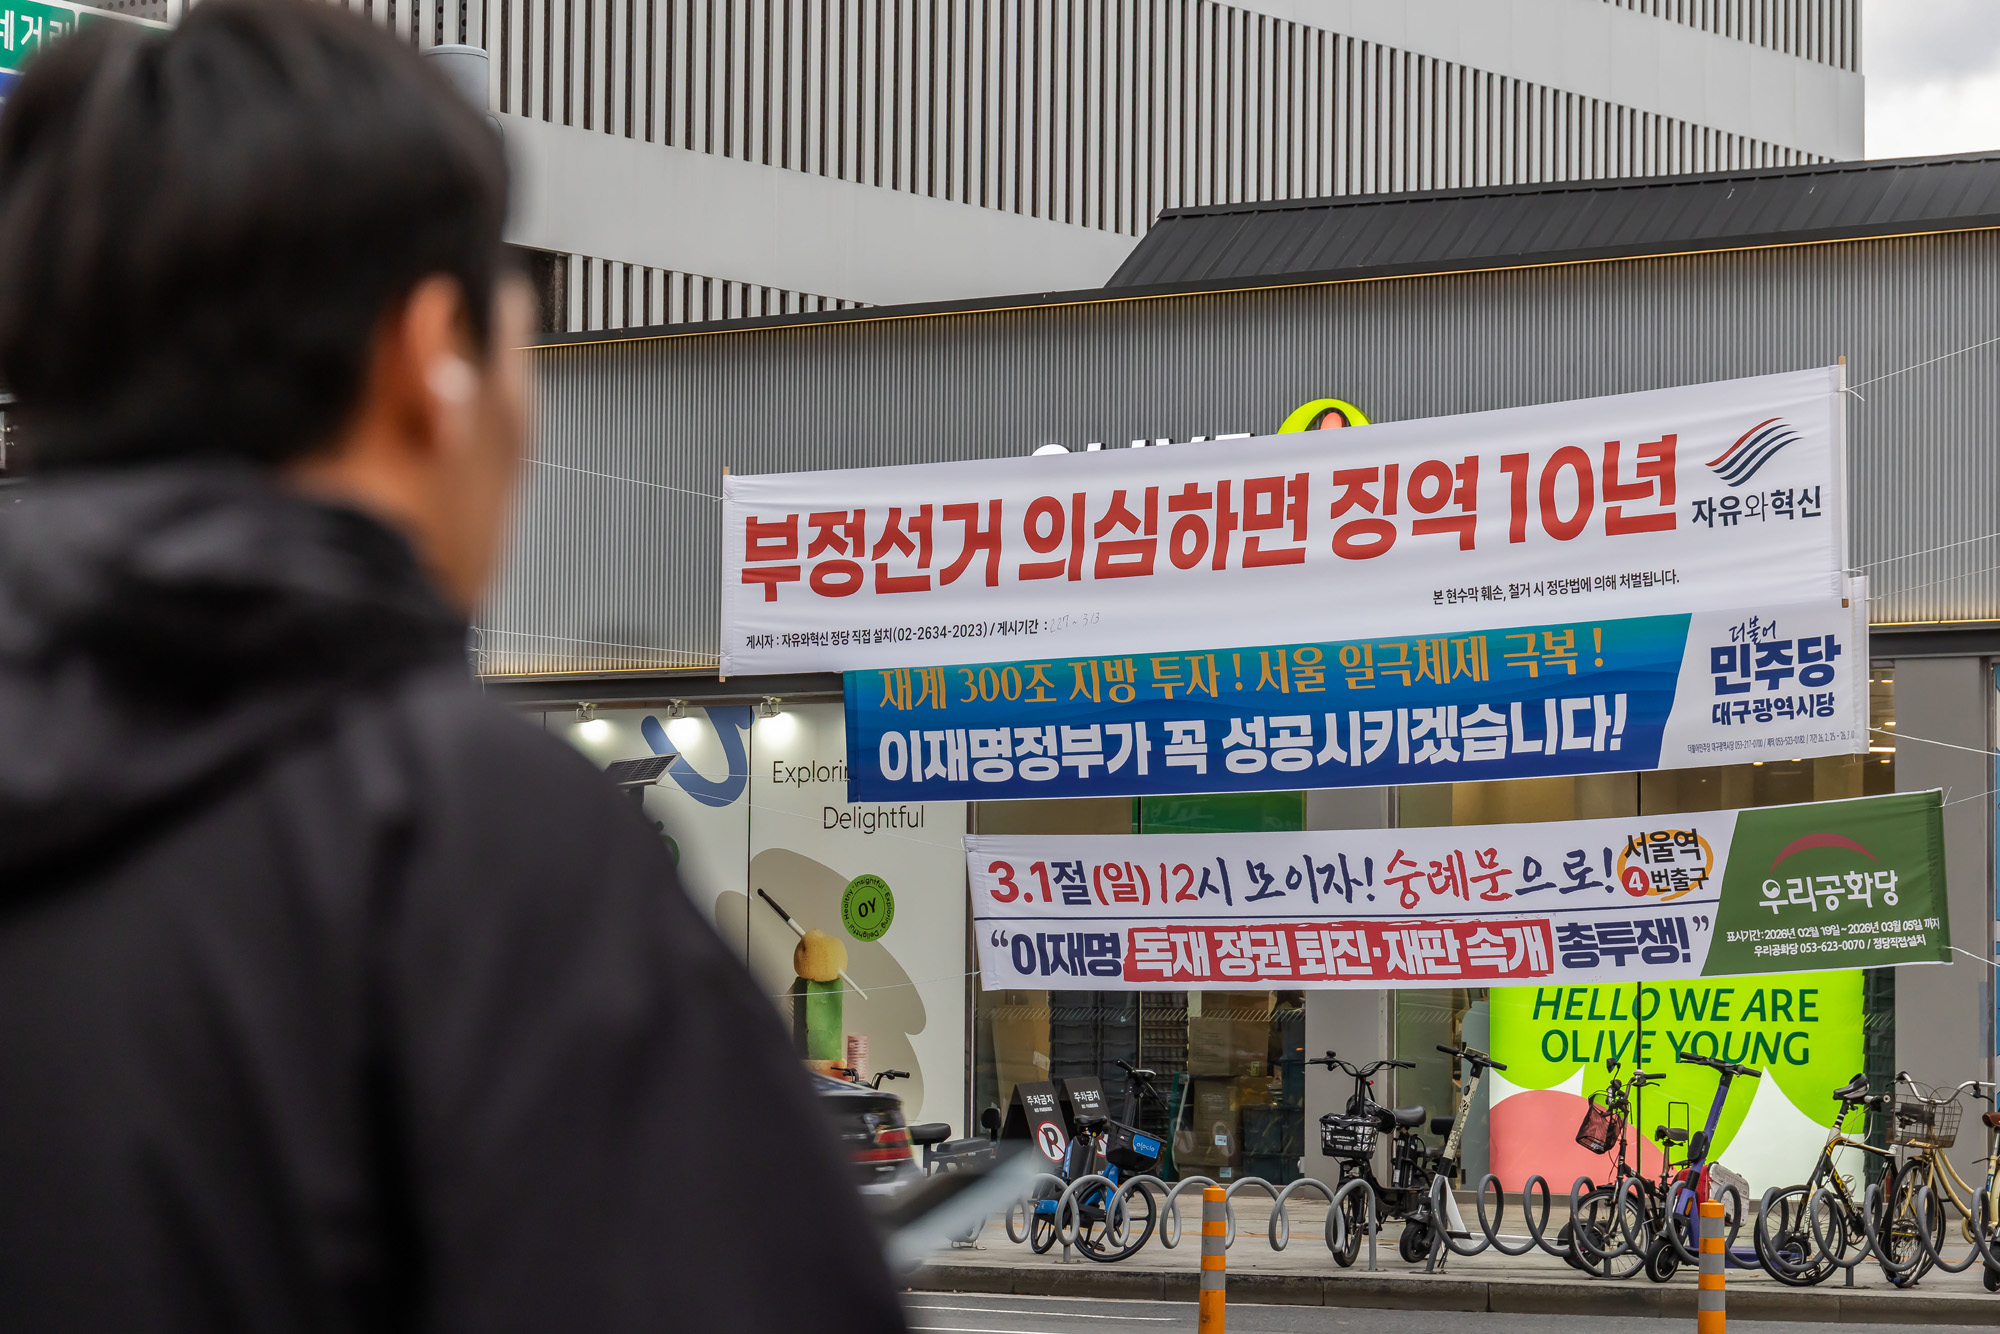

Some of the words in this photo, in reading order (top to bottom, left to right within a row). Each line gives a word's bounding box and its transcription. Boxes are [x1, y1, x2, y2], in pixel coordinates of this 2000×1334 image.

[741, 498, 1002, 602] 부정선거
[1018, 472, 1309, 582] 의심하면
[1330, 455, 1480, 561] 징역
[1500, 433, 1678, 544] 10년
[1691, 485, 1822, 529] 자유와혁신
[1432, 589, 1443, 605] 본
[1445, 588, 1479, 604] 현수막
[1481, 585, 1507, 602] 훼손,
[1508, 582, 1530, 599] 철거
[1533, 580, 1544, 596] 시
[1546, 577, 1592, 595] 정당법에
[1594, 574, 1617, 592] 의해
[1619, 568, 1680, 589] 처벌됩니다.
[745, 634, 774, 650] 게시자
[781, 631, 829, 648] 자유와혁신
[830, 630, 850, 646] 정당
[852, 628, 871, 644] 직접
[873, 621, 988, 644] 설치(02-2634-2023)
[997, 618, 1039, 636] 게시기간
[1728, 615, 1777, 644] 더불어
[878, 666, 948, 711] 재계
[957, 663, 1057, 704] 300조
[1067, 657, 1138, 703] 지방
[1150, 653, 1221, 699] 투자
[1255, 646, 1327, 693] 서울
[1338, 635, 1490, 690] 일극체제
[1503, 628, 1579, 678] 극복
[1710, 634, 1842, 696] 민주당
[1711, 691, 1835, 726] 대구광역시당
[879, 721, 1152, 782] 이재명정부가
[1163, 719, 1208, 775] 꼭
[1221, 693, 1628, 774] 성공시키겠습니다!
[823, 805, 925, 834] Delightful
[1623, 828, 1702, 865] 서울역
[987, 860, 1151, 906] 3.1절(일)
[1160, 857, 1233, 906] 12시
[1245, 852, 1375, 904] 모이자!
[1383, 847, 1615, 910] 숭례문으로!
[1759, 869, 1899, 915] 우리공화당
[843, 889, 854, 921] Healthy
[880, 891, 893, 929] Exploring
[858, 897, 877, 918] OY
[1753, 942, 1799, 957] 우리공화당
[1799, 939, 1866, 954] 053-623-0070
[1872, 933, 1927, 950] 정당직접설치
[1797, 925, 1820, 938] 02월
[1881, 919, 1902, 933] 03월
[1902, 918, 1923, 931] 05일
[1923, 917, 1940, 930] 까지
[1134, 931, 1211, 977] 독재
[1215, 930, 1292, 977] 정권
[1466, 924, 1550, 974] 속개
[1532, 986, 1661, 1022] HELLO
[1669, 987, 1735, 1022] WE
[1740, 988, 1819, 1022] ARE
[1541, 1029, 1657, 1063] OLIVE
[1666, 1030, 1810, 1066] YOUNG
[1026, 1093, 1054, 1106] 주차금지
[1073, 1089, 1101, 1103] 주차금지
